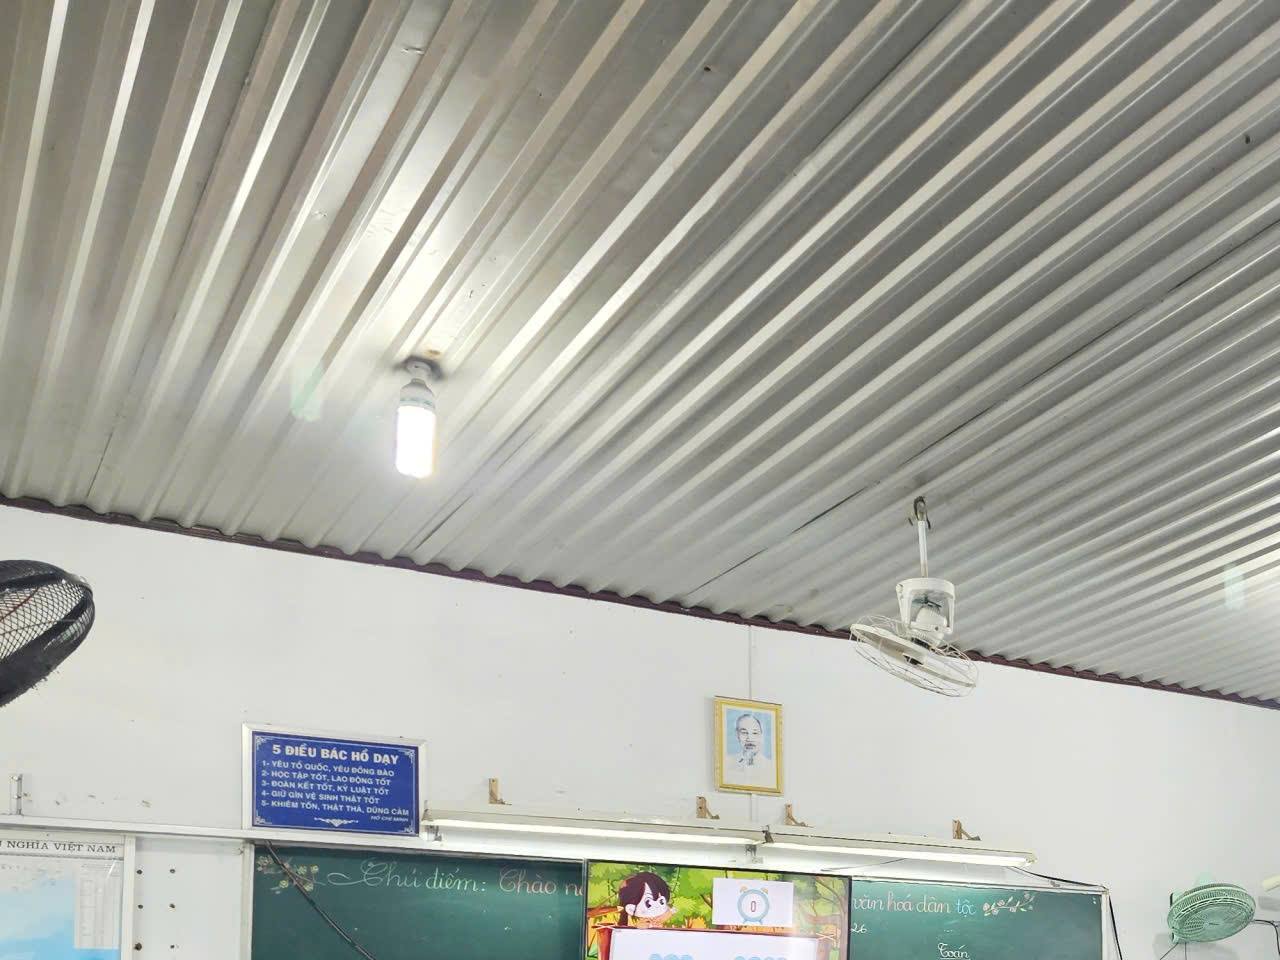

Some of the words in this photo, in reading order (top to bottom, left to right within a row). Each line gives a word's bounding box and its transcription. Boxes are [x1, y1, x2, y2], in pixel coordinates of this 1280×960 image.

[272, 744, 281, 755] 5
[285, 742, 317, 758] ĐIỀU
[320, 747, 348, 760] BÁC
[351, 748, 369, 762] HỒ
[373, 753, 399, 766] DẠY
[271, 760, 289, 769] YÊU
[333, 765, 350, 774] YÊU
[271, 770, 290, 779] HỌC
[331, 775, 348, 783] LAO
[375, 777, 391, 786] TỐT
[318, 793, 339, 801] SINH
[6, 840, 49, 850] NGHĨA
[54, 842, 84, 853] VIỆT
[87, 844, 116, 853] NAM
[956, 898, 977, 918] tộc
[938, 942, 971, 960] Toán
